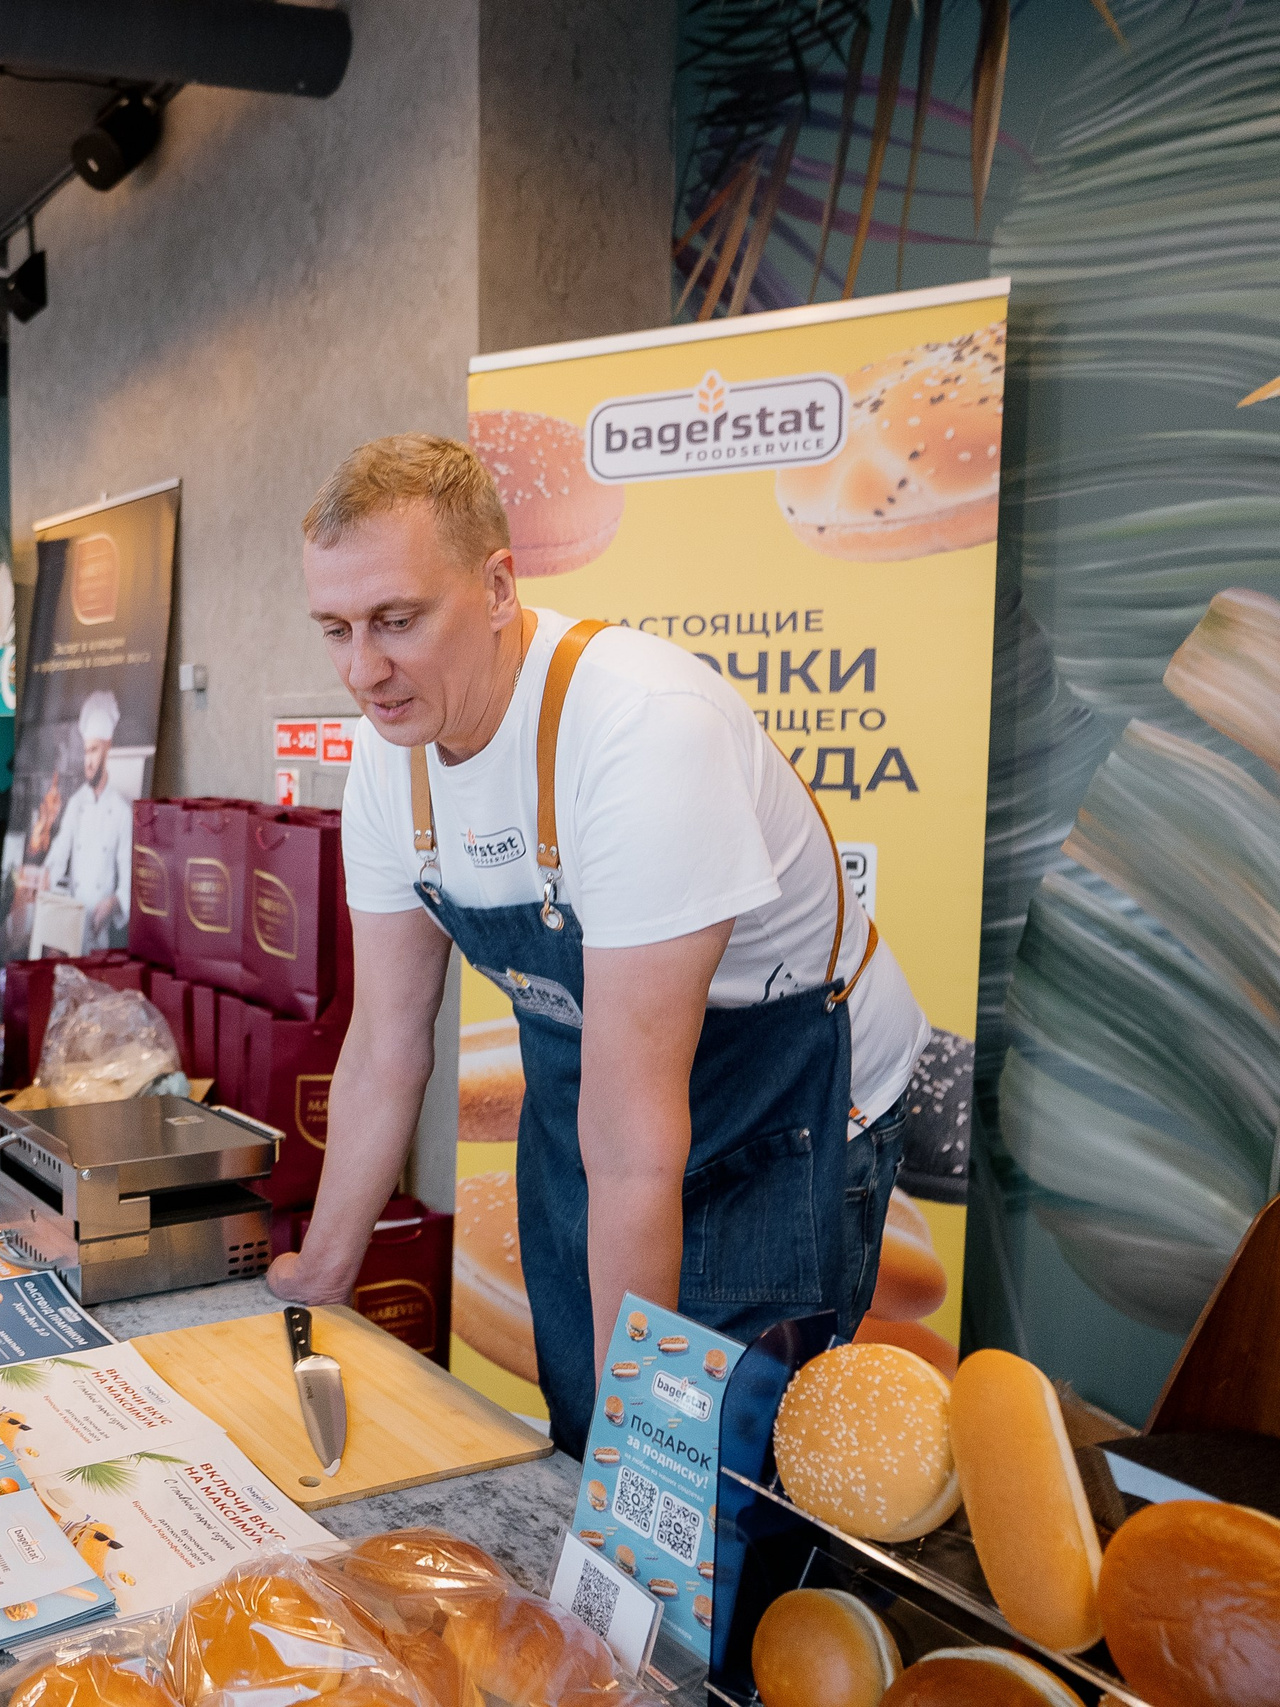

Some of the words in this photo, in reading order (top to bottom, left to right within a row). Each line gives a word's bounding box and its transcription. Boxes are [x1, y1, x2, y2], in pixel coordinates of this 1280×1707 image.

[605, 400, 825, 456] bagerstat
[685, 438, 825, 462] FOODSERVICE
[604, 609, 824, 638] СТОЯЩИЕ
[790, 747, 919, 801] ДА
[23, 1280, 56, 1316] ФАСТФУД
[48, 1312, 88, 1346] ПРАКТИКУМ
[91, 1370, 107, 1384] НА
[103, 1383, 158, 1430] МАКСИМУМ
[104, 1367, 147, 1406] ВКЛЮЧИ
[143, 1404, 173, 1426] ВКУС
[656, 1377, 708, 1412] bagerstat
[626, 1434, 641, 1449] за
[642, 1443, 710, 1490] подписку!
[629, 1414, 712, 1471] ПОДАРОК
[183, 1465, 203, 1484] НА
[199, 1461, 253, 1514] ВКЛЮЧИ
[12, 1528, 40, 1560] bagerstat
[131, 1500, 155, 1524] Бриошь
[154, 1527, 197, 1570] Картофельная
[156, 1518, 184, 1544] датского
[178, 1528, 206, 1553] Булочки
[200, 1550, 217, 1563] для
